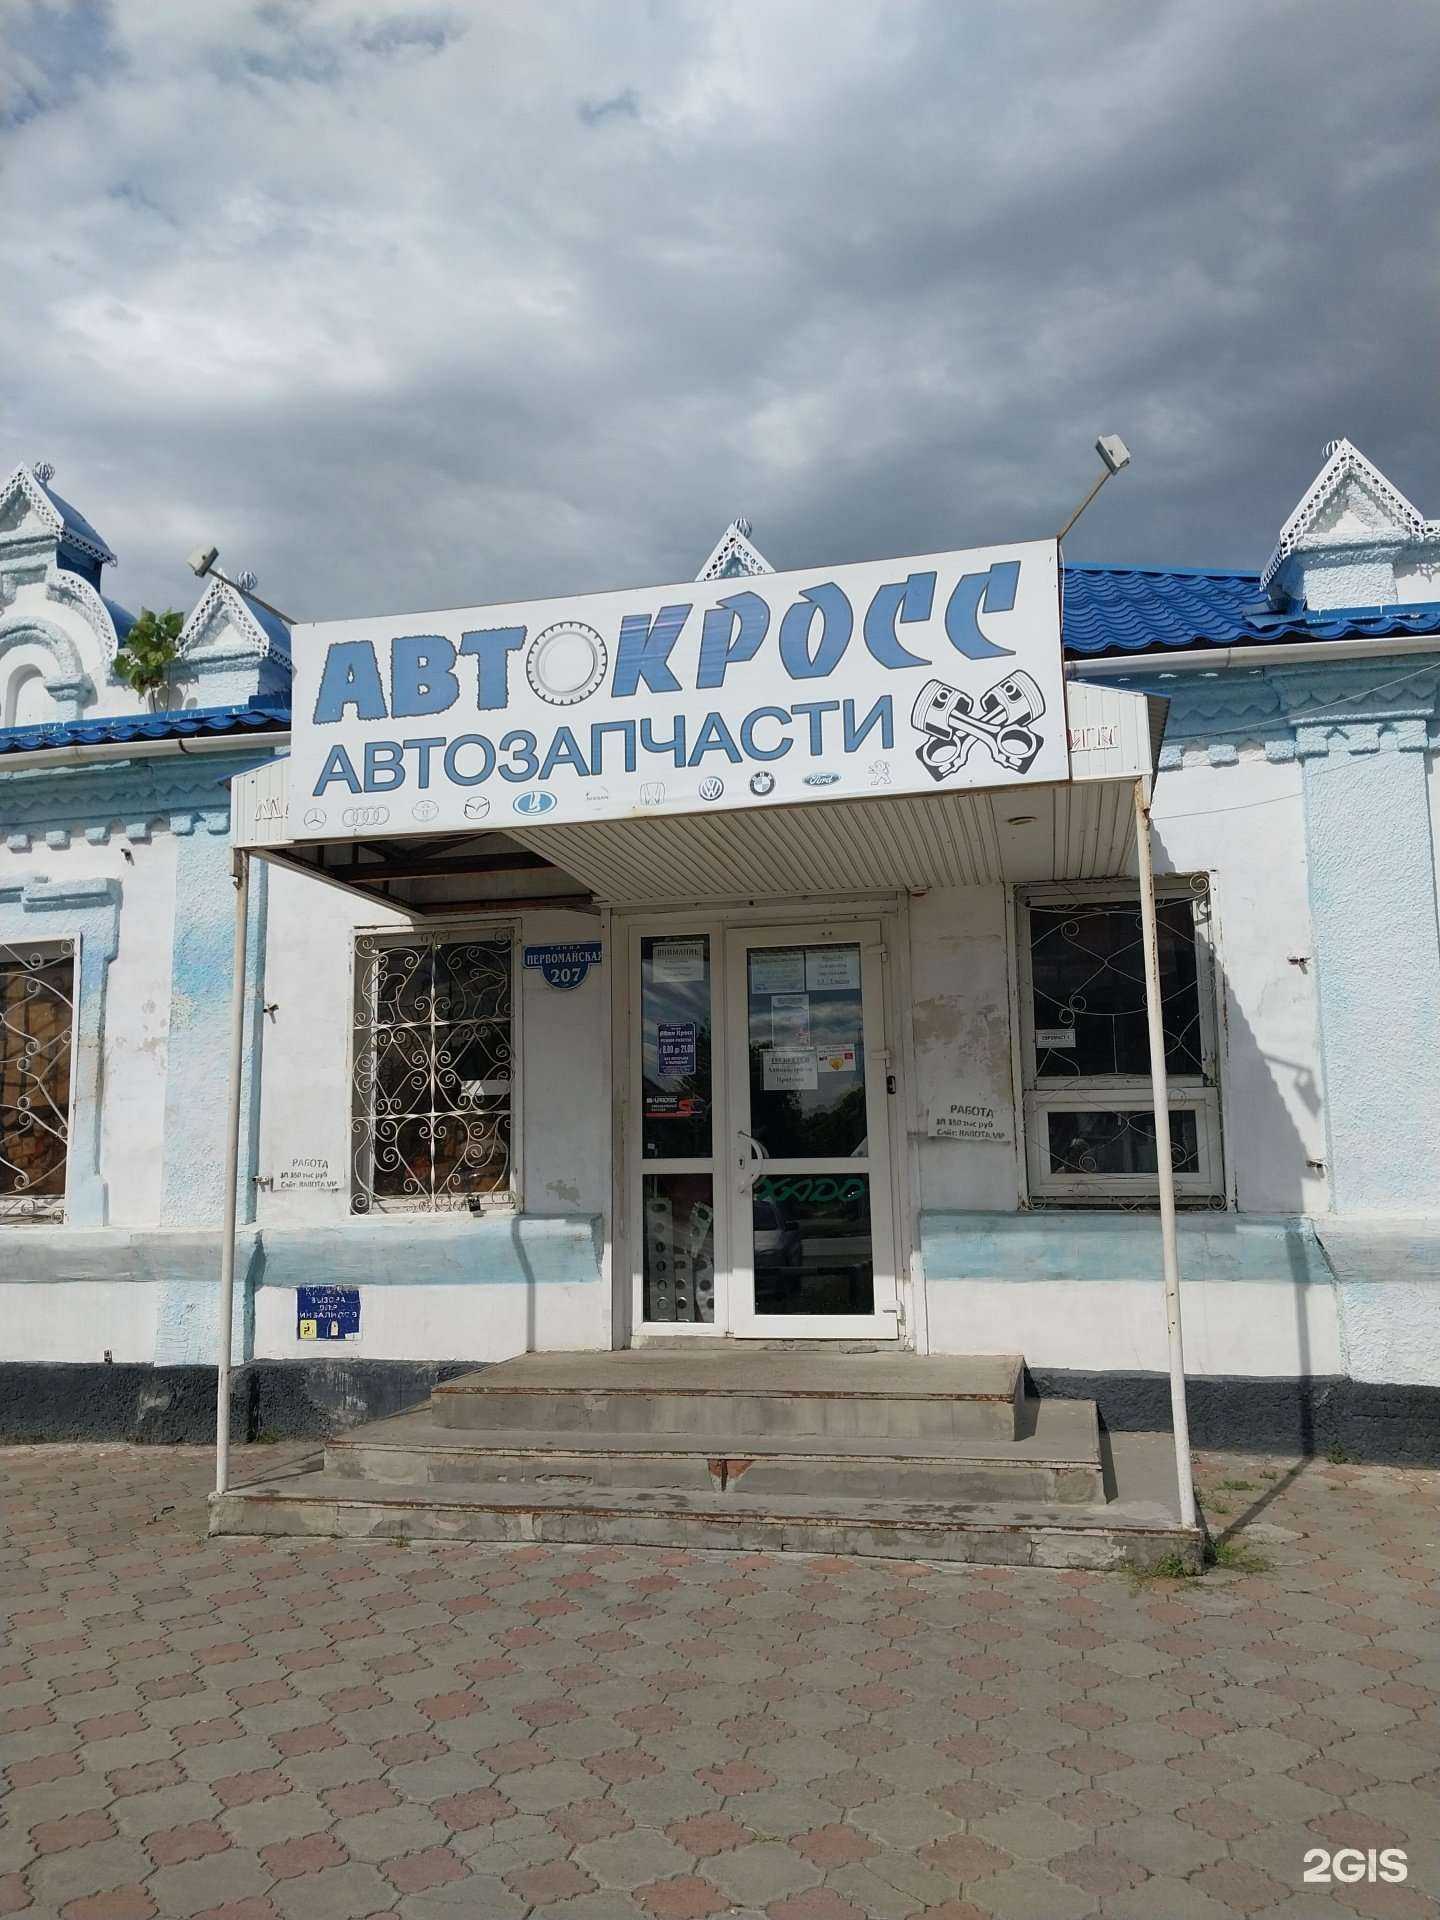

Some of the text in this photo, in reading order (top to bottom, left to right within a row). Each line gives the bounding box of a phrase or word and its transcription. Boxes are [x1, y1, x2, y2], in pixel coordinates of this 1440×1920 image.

[312, 694, 895, 797] АВТОЗАПЧАСТИ
[550, 967, 581, 983] 207
[950, 1104, 994, 1119] РАБОТА
[292, 1158, 329, 1169] РАБОТА
